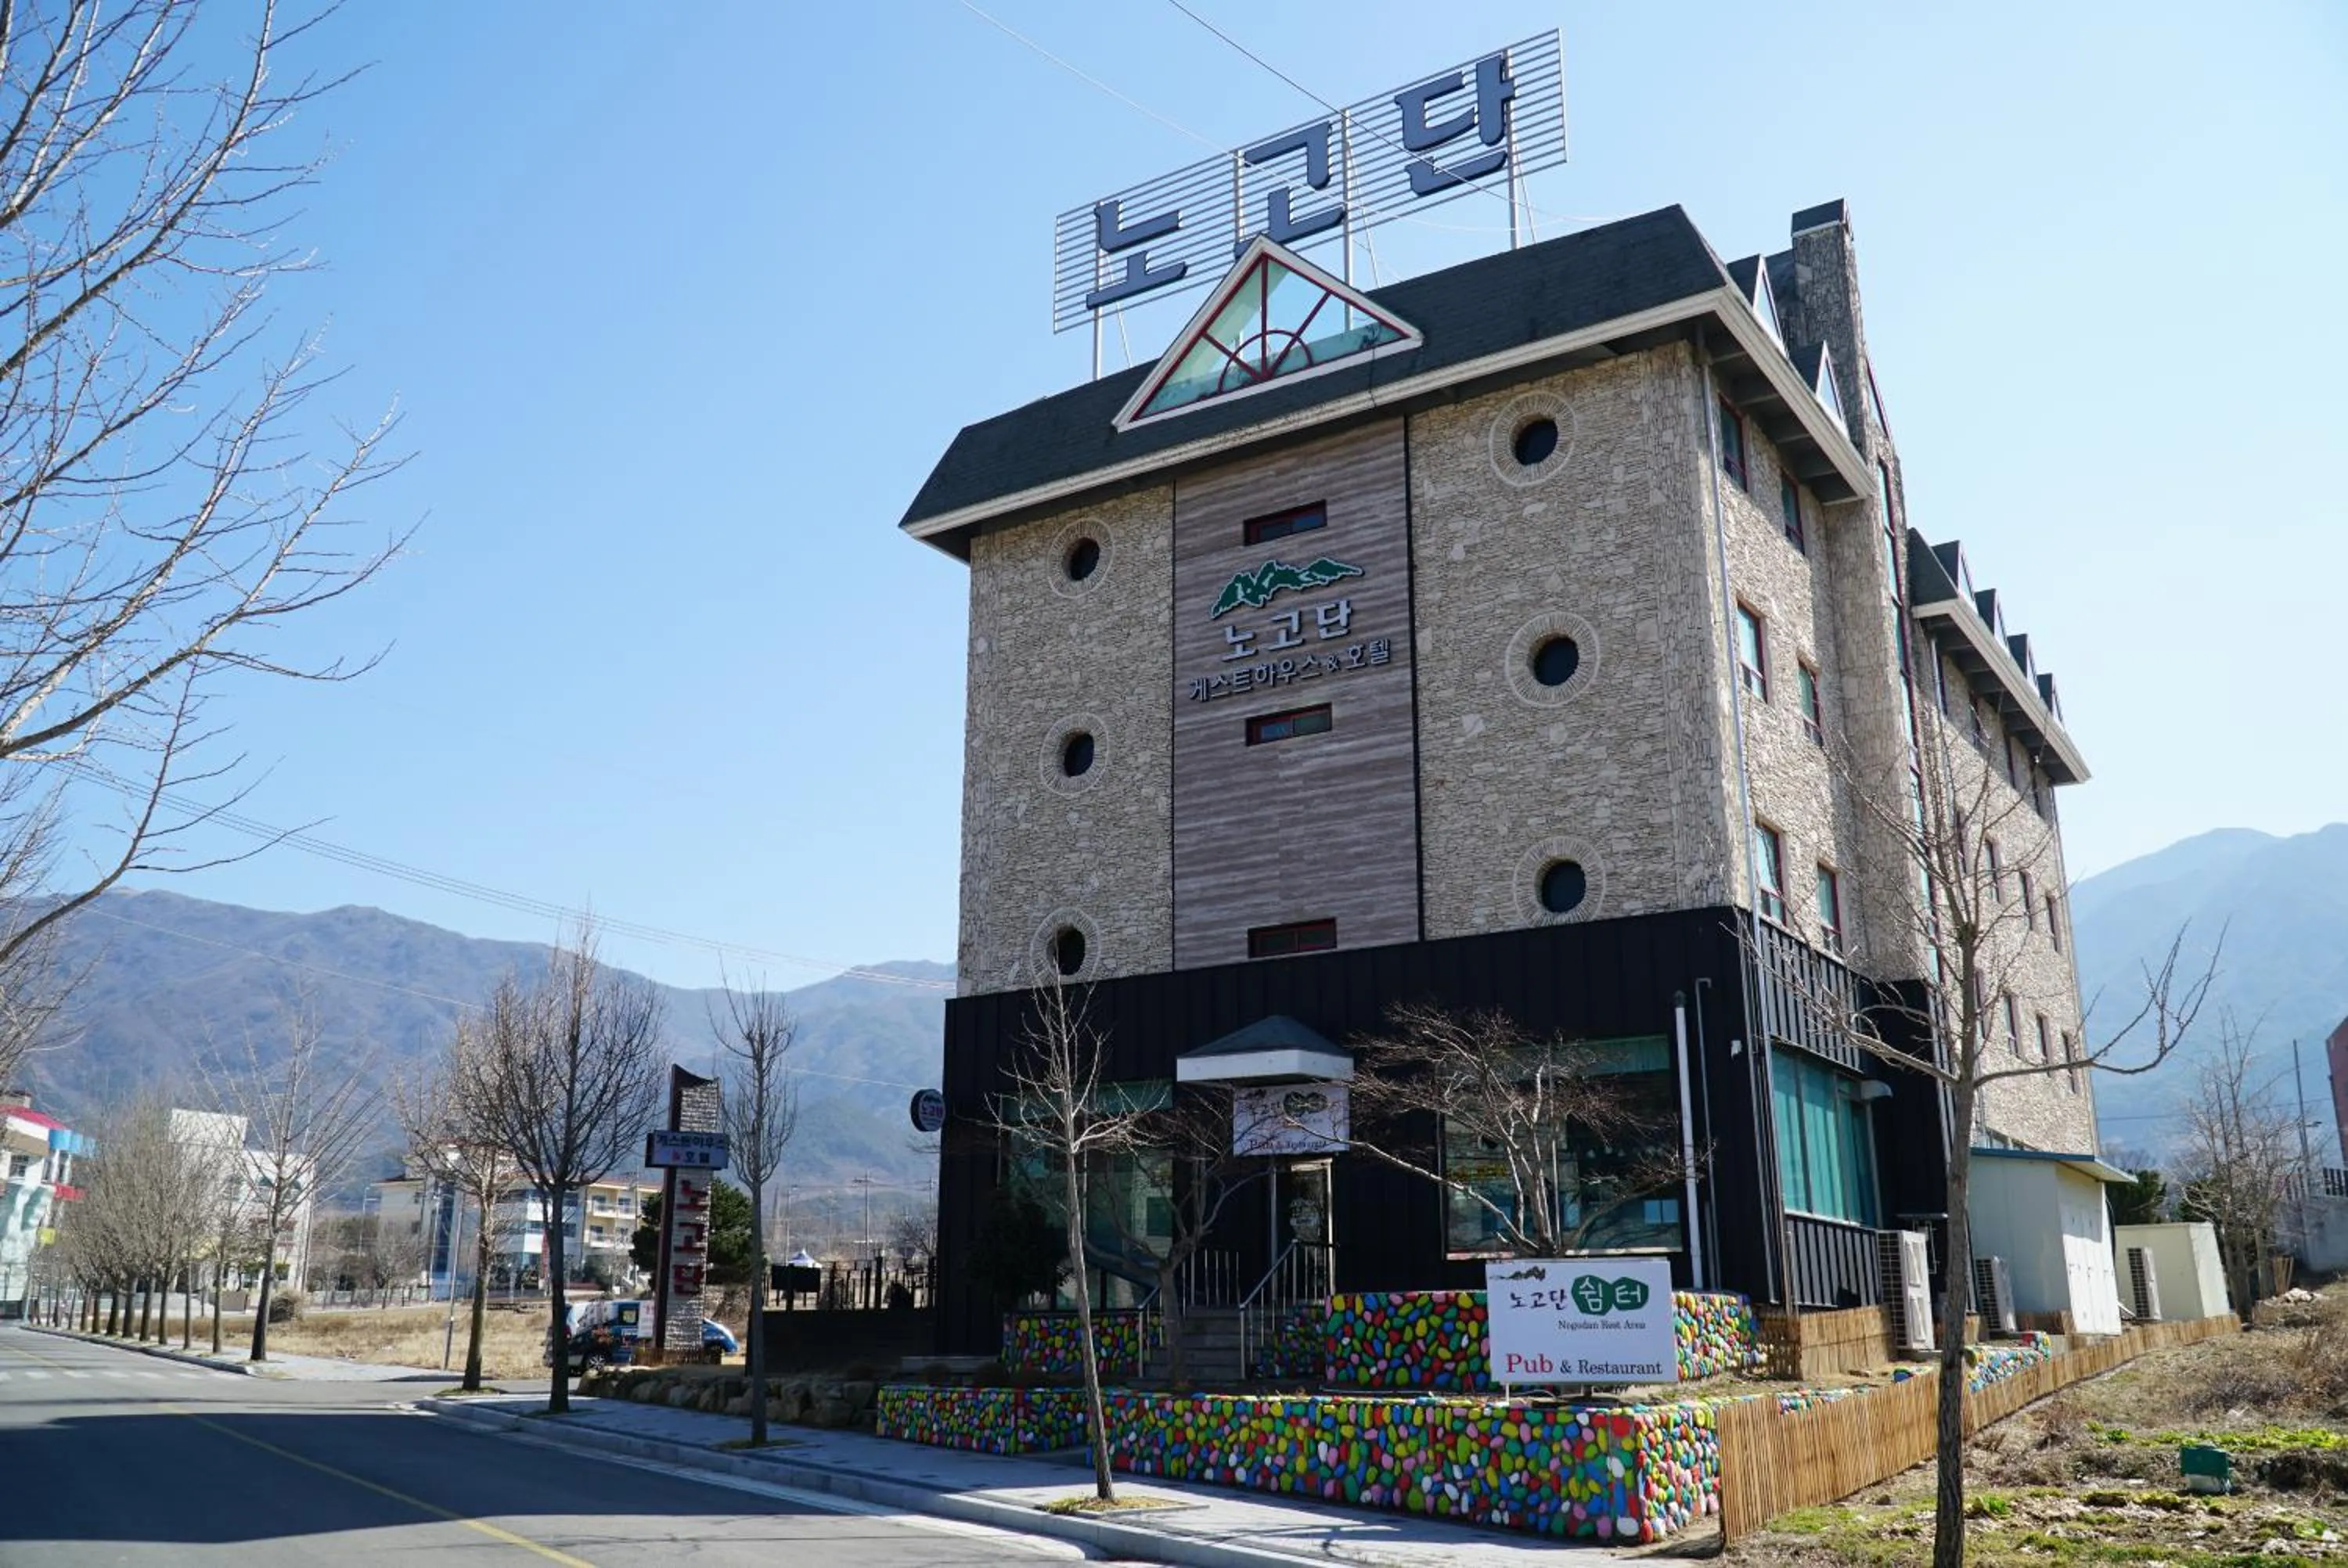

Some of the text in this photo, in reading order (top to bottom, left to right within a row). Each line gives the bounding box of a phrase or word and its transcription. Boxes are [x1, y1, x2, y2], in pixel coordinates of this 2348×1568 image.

[1086, 53, 1516, 311] 노고단
[1222, 599, 1352, 662] 노고단
[673, 1179, 709, 1298] 노고단
[1510, 1275, 1642, 1313] 노고단 쉼터
[1558, 1319, 1599, 1331] Nogodan
[1505, 1353, 1663, 1376] Pub & Restaurant
